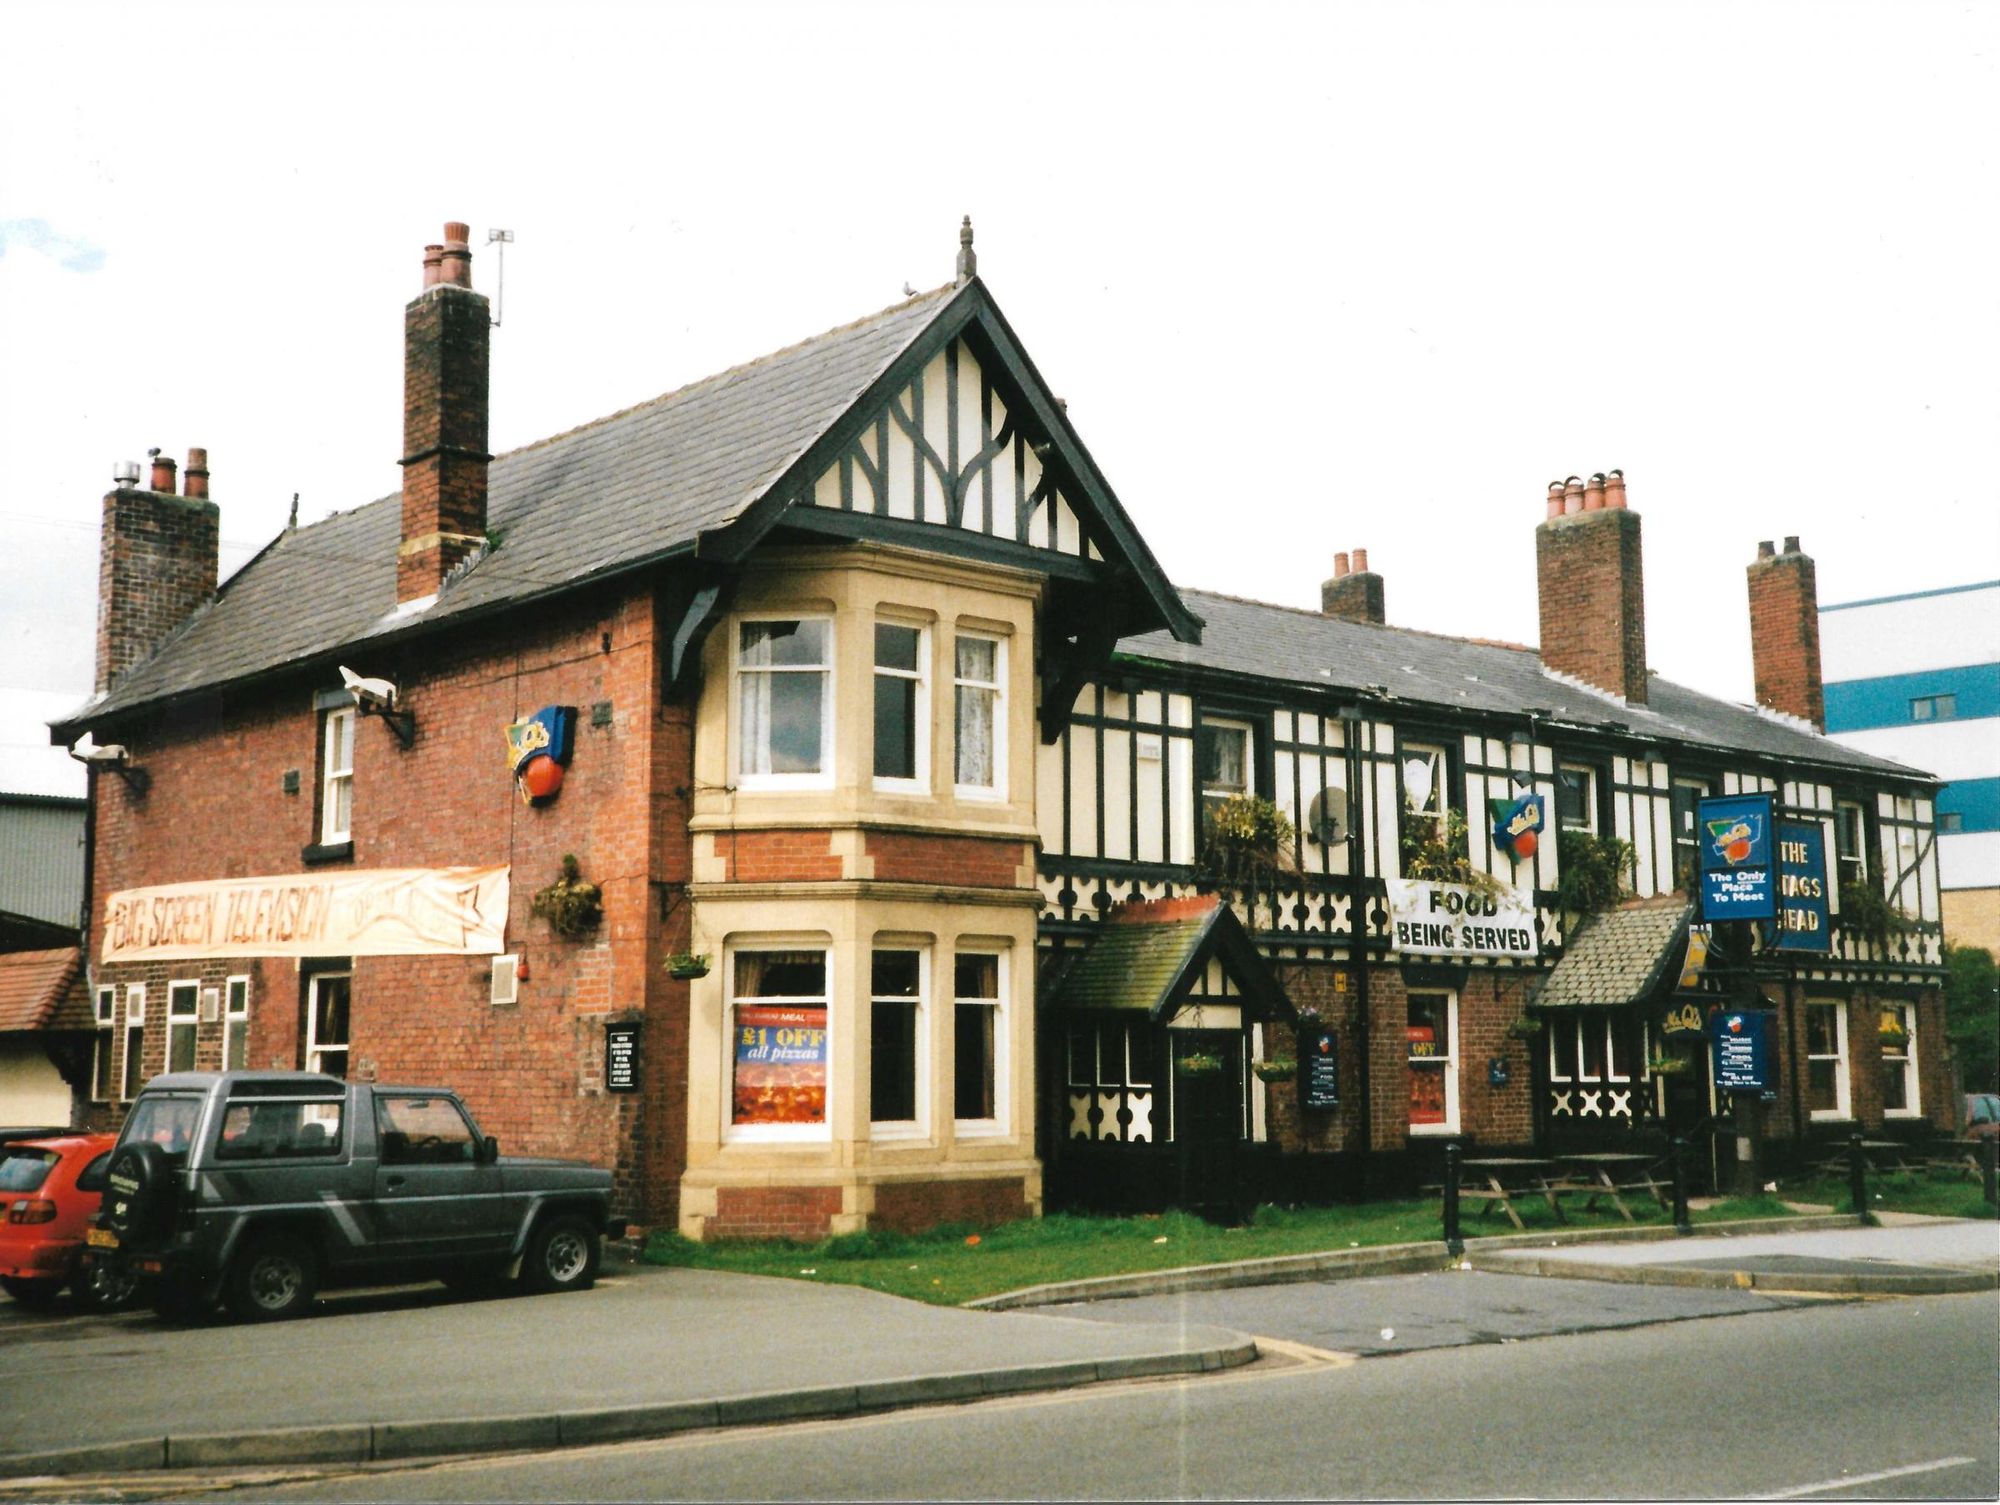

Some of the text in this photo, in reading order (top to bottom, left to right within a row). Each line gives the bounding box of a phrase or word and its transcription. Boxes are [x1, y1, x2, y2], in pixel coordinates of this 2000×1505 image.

[1781, 842, 1808, 864] THE
[1709, 872, 1766, 883] The Only
[1429, 890, 1498, 917] FOOD
[1713, 893, 1729, 902] To
[111, 898, 145, 949] BIG
[149, 892, 217, 946] SCREEN
[224, 884, 334, 944] TELEVISION
[1397, 922, 1531, 951] BEING SERVED
[742, 1027, 827, 1047] £1 OFF
[748, 1046, 819, 1062] all pizzas
